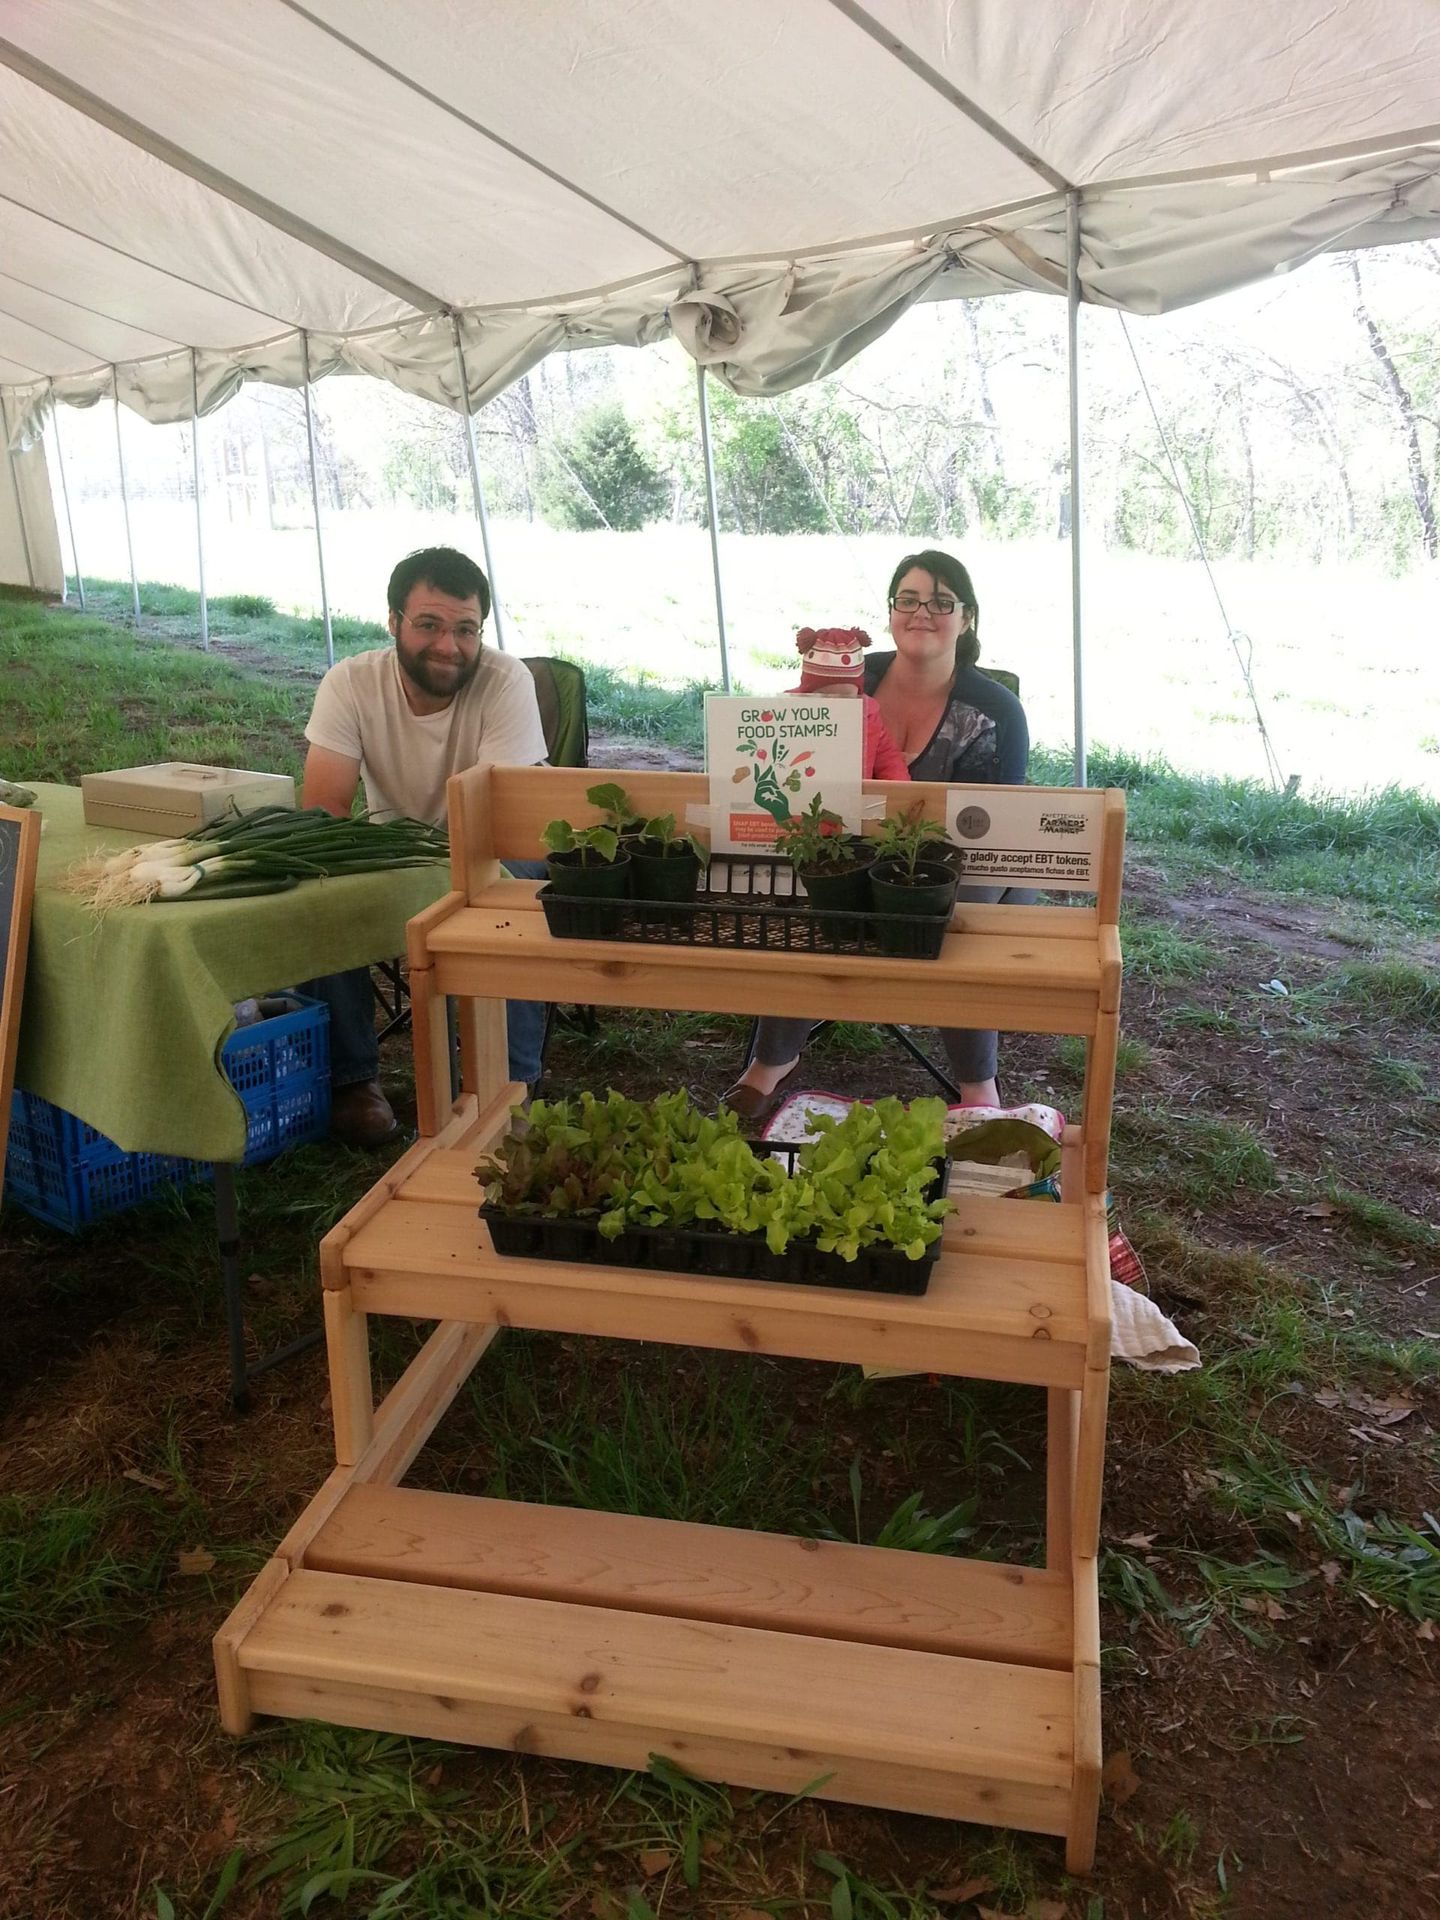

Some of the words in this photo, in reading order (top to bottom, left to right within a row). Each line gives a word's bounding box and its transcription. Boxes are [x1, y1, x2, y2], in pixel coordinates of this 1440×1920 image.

[741, 709, 787, 723] GROW
[791, 707, 830, 721] YOUR
[738, 725, 776, 739] FOOD
[779, 724, 838, 738] STAMPS!
[970, 852, 998, 864] gladly
[1000, 854, 1033, 864] accept
[1035, 854, 1054, 864] EBT
[1056, 855, 1091, 866] tokens.
[990, 865, 1008, 874] gusto
[1009, 866, 1044, 875] aceptamos
[1066, 868, 1075, 876] de
